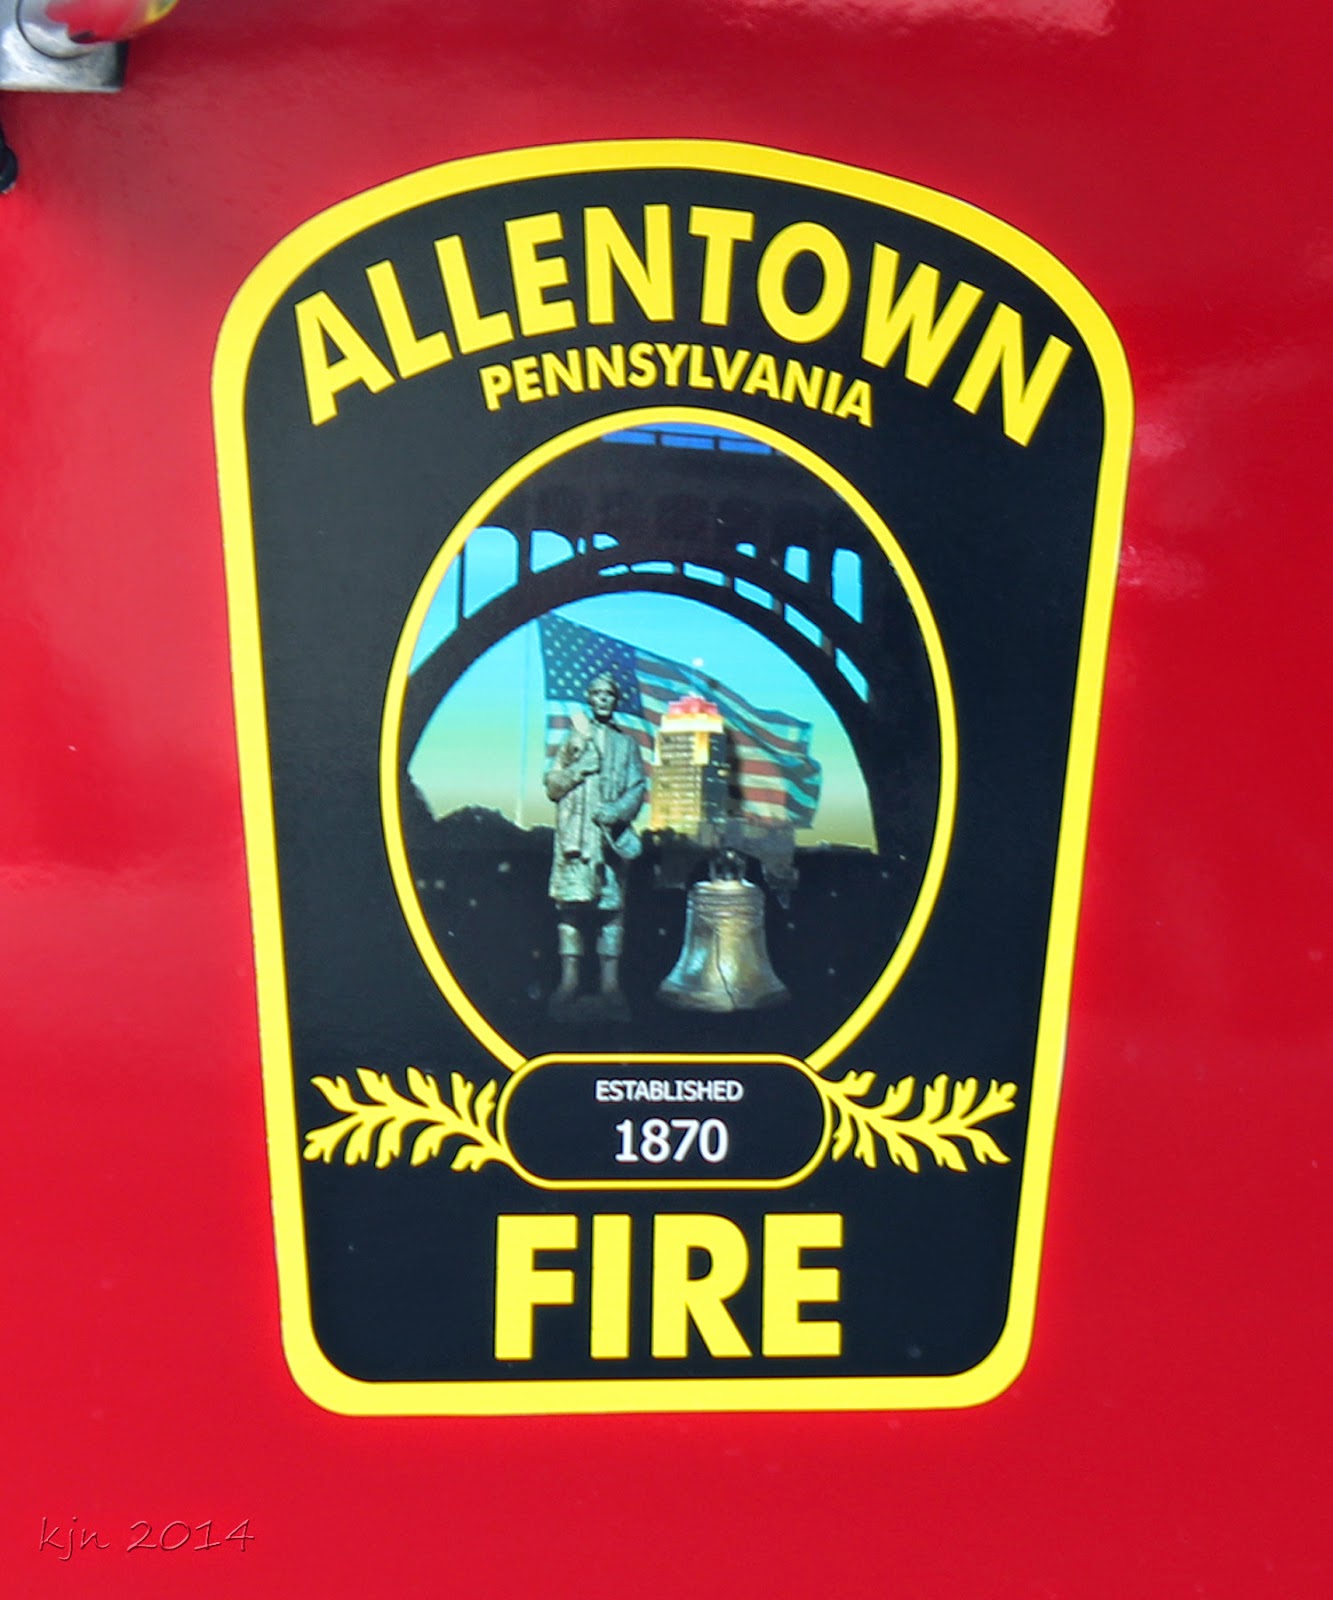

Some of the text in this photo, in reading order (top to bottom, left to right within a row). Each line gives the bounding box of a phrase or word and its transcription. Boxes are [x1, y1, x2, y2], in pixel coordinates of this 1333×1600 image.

[295, 204, 1073, 447] ALLENTOWN
[480, 342, 874, 428] PENNSYLVANIA
[595, 1079, 744, 1102] ESTABLISHED
[614, 1118, 729, 1163] 1870
[495, 1213, 843, 1361] FIRE
